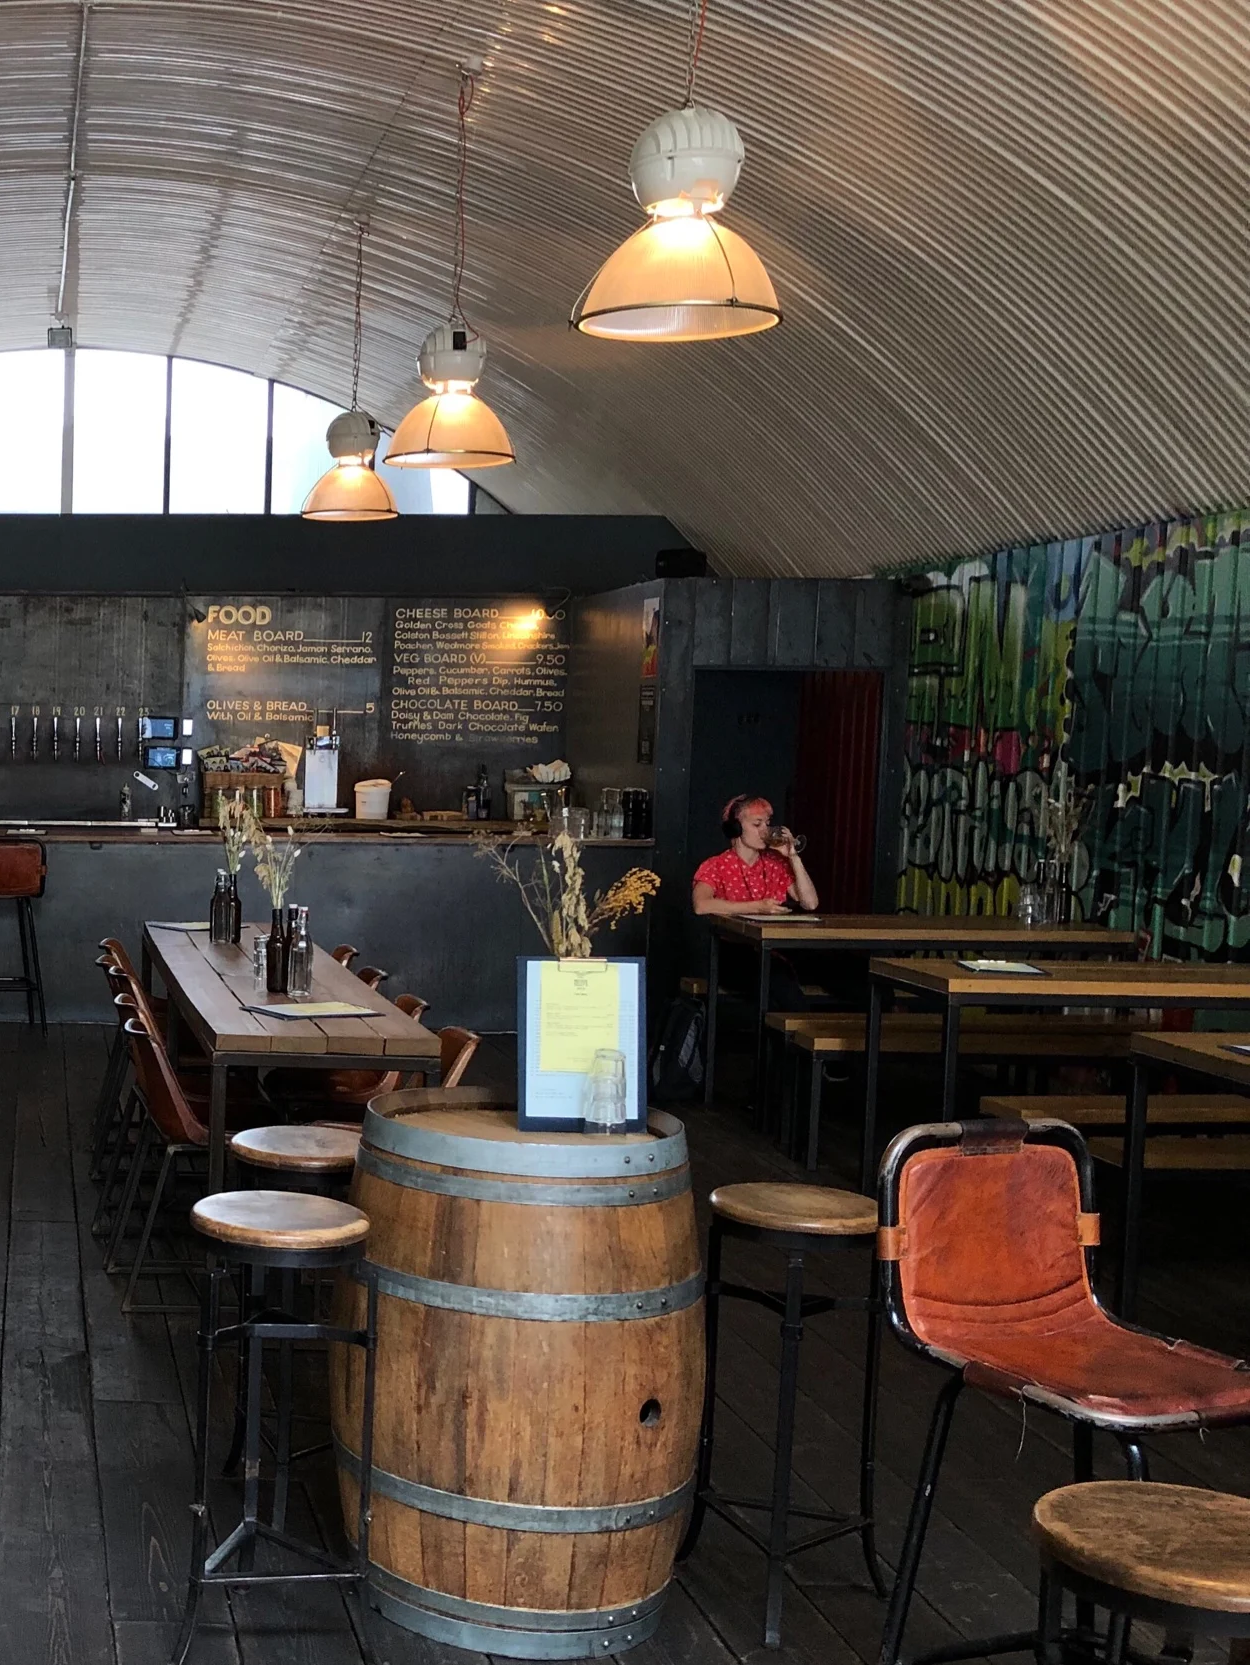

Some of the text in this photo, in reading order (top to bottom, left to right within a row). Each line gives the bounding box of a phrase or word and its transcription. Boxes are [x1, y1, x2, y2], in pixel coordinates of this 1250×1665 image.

[207, 605, 272, 625] FOOD
[395, 608, 448, 619] CHEESE
[454, 608, 499, 619] BOARD
[395, 621, 432, 629] Golden
[435, 621, 463, 629] Cross
[467, 621, 496, 629] Goats
[207, 630, 372, 643] MEAT BOARD 12
[394, 631, 430, 640] Colston
[298, 644, 327, 653] Jamon
[436, 642, 480, 650] Wedmore
[237, 654, 260, 663] Olive
[262, 654, 274, 663] Oil
[394, 653, 566, 665] VEG BOARD (V) 9.50
[216, 664, 245, 672] Bread
[407, 677, 430, 685] Red
[439, 676, 488, 686] Peppers
[392, 687, 416, 696] Olive
[535, 688, 565, 698] Bread
[11, 706, 20, 715] 17
[32, 706, 40, 716] 18
[52, 706, 61, 716] 19
[74, 706, 85, 716] 20
[94, 707, 103, 716] 21
[116, 707, 126, 716] 22
[138, 707, 149, 716] 23
[207, 700, 375, 713] OLIVES & BREAD 5
[391, 699, 563, 712] CHOCOLATE BOARD 7.50
[207, 711, 314, 722] With Oil & Balsamic
[391, 711, 420, 722] Daisy
[423, 711, 432, 720] &
[433, 712, 454, 720] Dam
[515, 713, 529, 724] Fig
[391, 721, 433, 730] Truffles
[438, 721, 463, 730] Dark
[468, 722, 526, 732] Chocolate
[390, 732, 538, 744] Honeycomb & Strawerries
